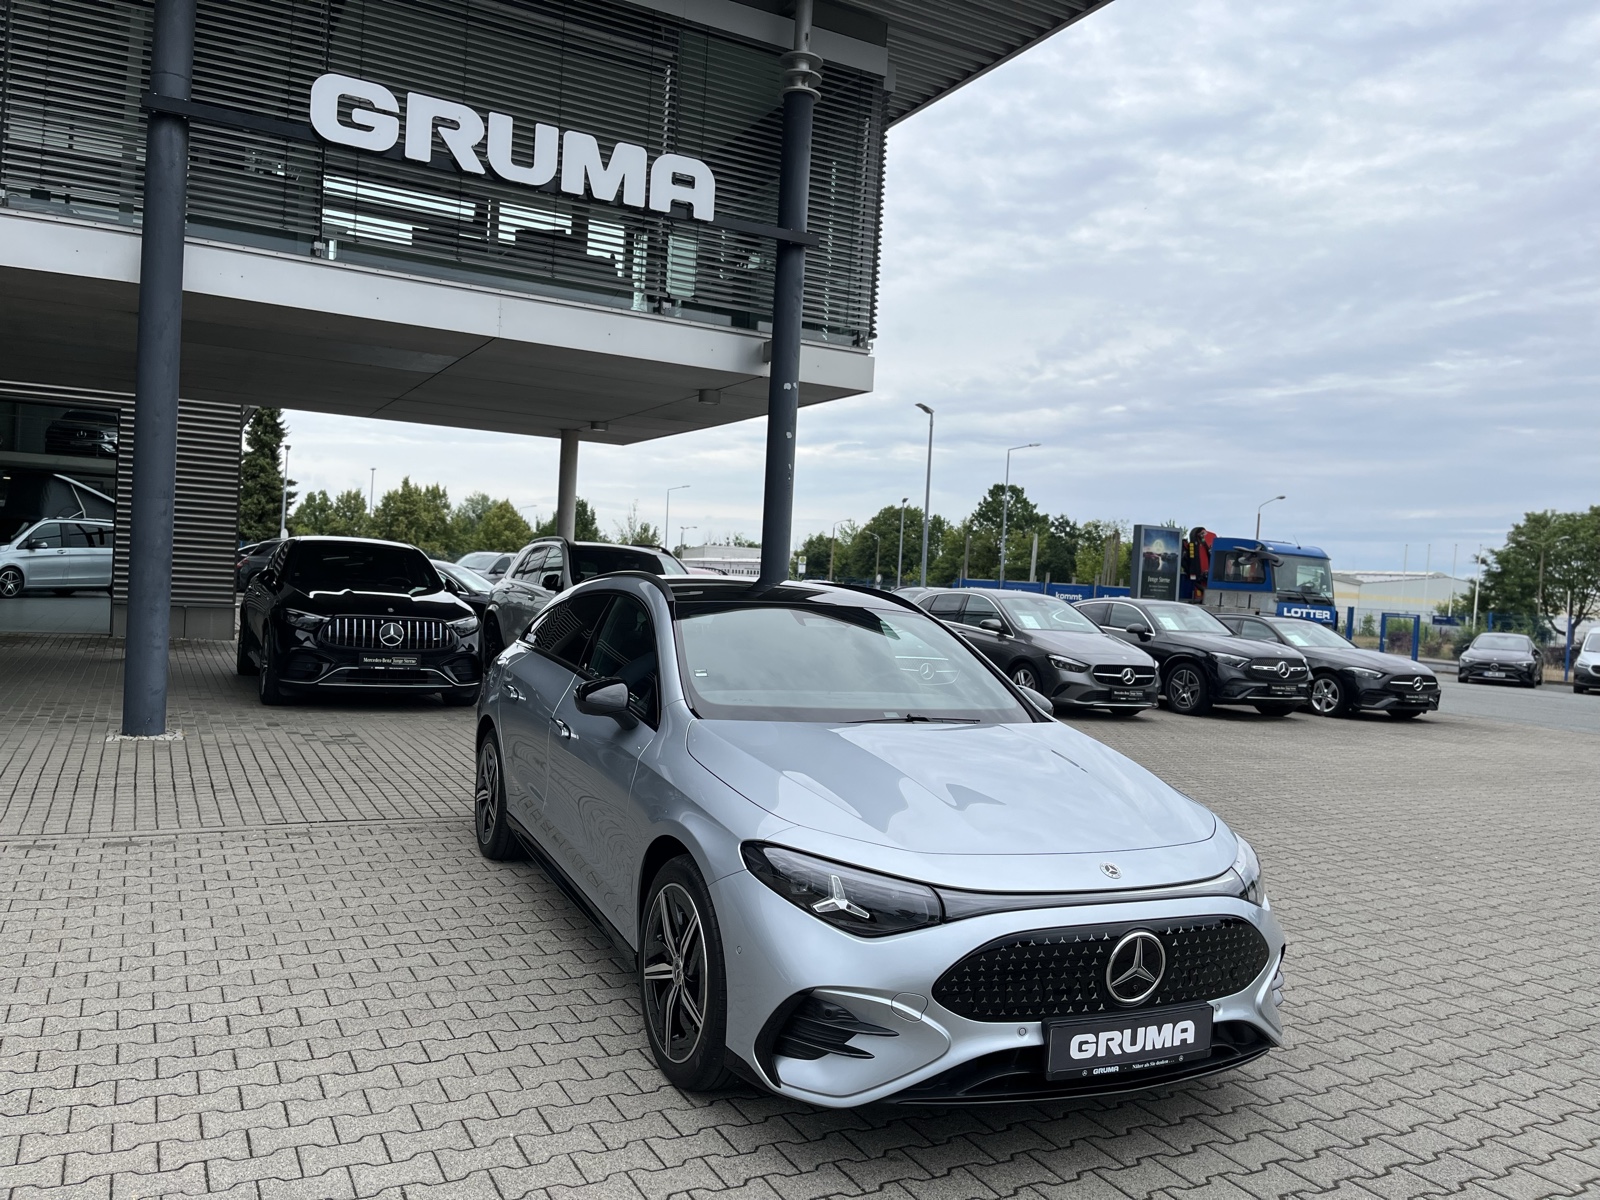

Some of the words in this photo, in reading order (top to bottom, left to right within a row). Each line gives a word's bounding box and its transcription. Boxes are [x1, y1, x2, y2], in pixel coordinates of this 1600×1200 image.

[309, 73, 716, 222] GRUMA
[1055, 591, 1083, 601] kommt
[1283, 607, 1331, 620] LOTTER
[1069, 1020, 1196, 1060] GRUMA
[1093, 1065, 1119, 1075] GRUMA
